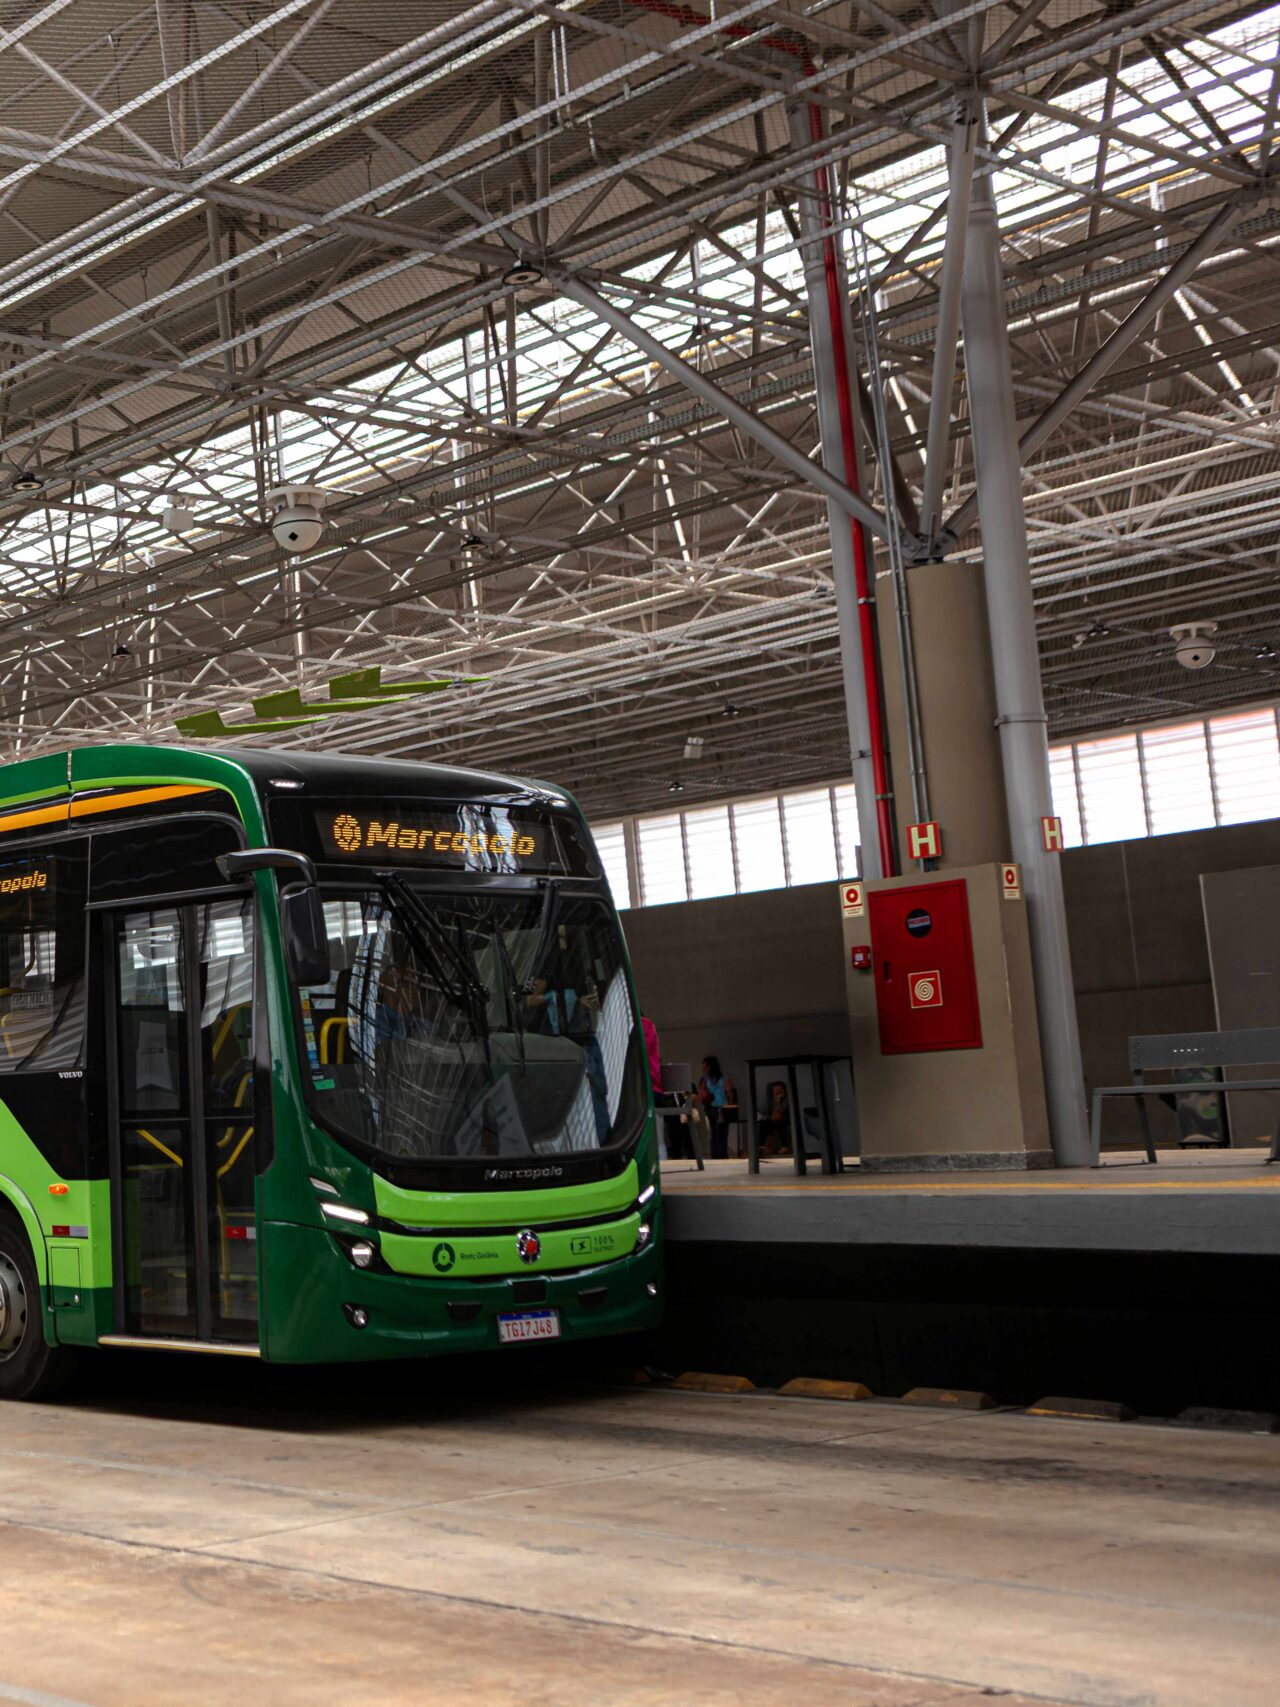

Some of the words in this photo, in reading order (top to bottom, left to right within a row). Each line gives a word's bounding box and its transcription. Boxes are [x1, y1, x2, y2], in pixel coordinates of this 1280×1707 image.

[366, 822, 536, 857] Marcopolo
[910, 824, 937, 857] H
[1043, 818, 1062, 850] H
[58, 1071, 83, 1079] VOLVO
[484, 1166, 563, 1181] Marcopolo
[593, 1235, 615, 1245] 100%
